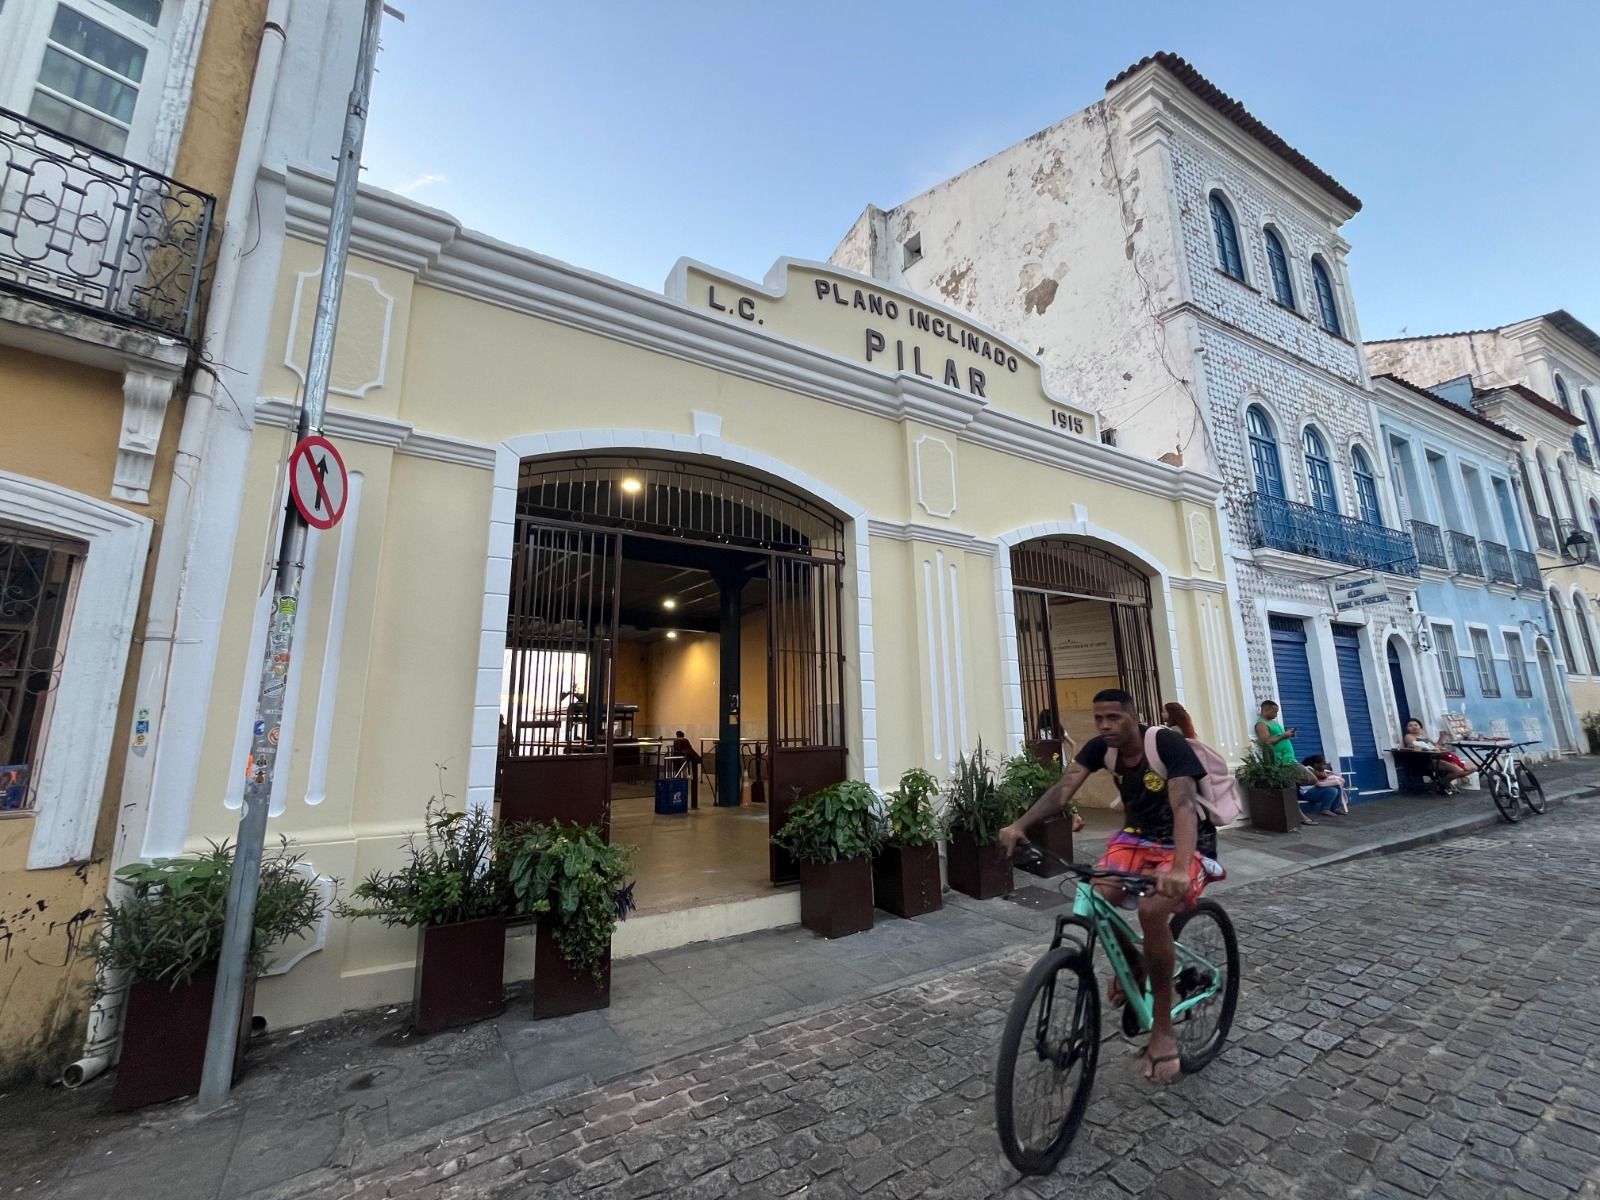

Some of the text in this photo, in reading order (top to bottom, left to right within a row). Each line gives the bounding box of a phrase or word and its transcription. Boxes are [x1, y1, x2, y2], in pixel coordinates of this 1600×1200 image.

[709, 285, 764, 325] L.C.
[815, 278, 1018, 373] PLANO INCLINADO
[865, 327, 986, 398] PILAR
[1051, 408, 1084, 434] 1915
